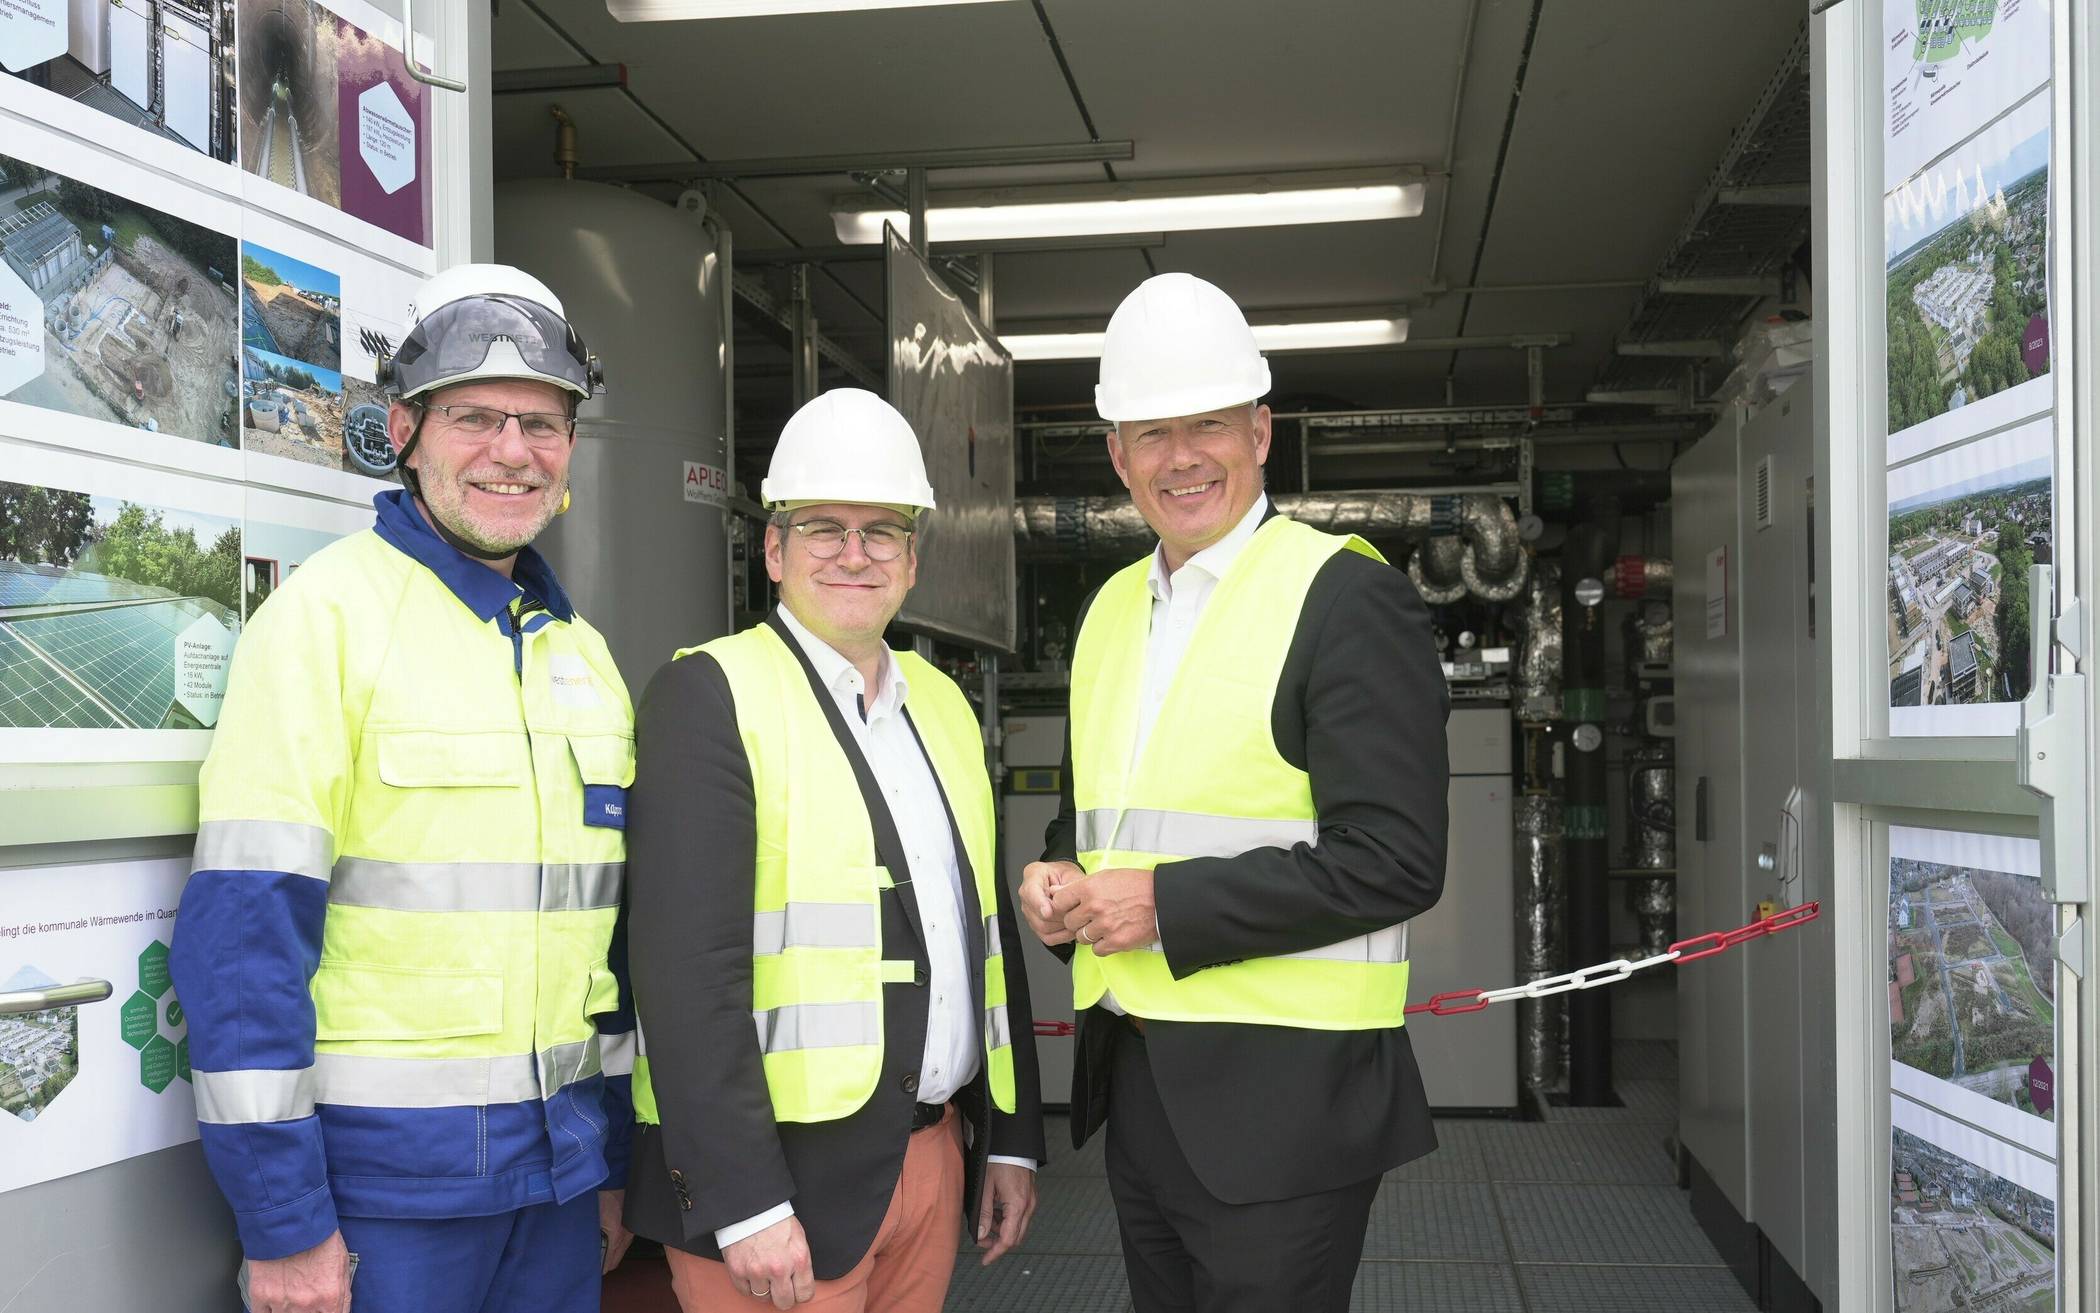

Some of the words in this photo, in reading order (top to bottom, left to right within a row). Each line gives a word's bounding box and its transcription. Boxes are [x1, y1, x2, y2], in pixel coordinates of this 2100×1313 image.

[184, 661, 221, 670] Energiezentrale
[22, 923, 36, 935] die
[38, 918, 88, 933] kommunale
[90, 911, 144, 927] Wärmewende
[145, 910, 155, 921] im
